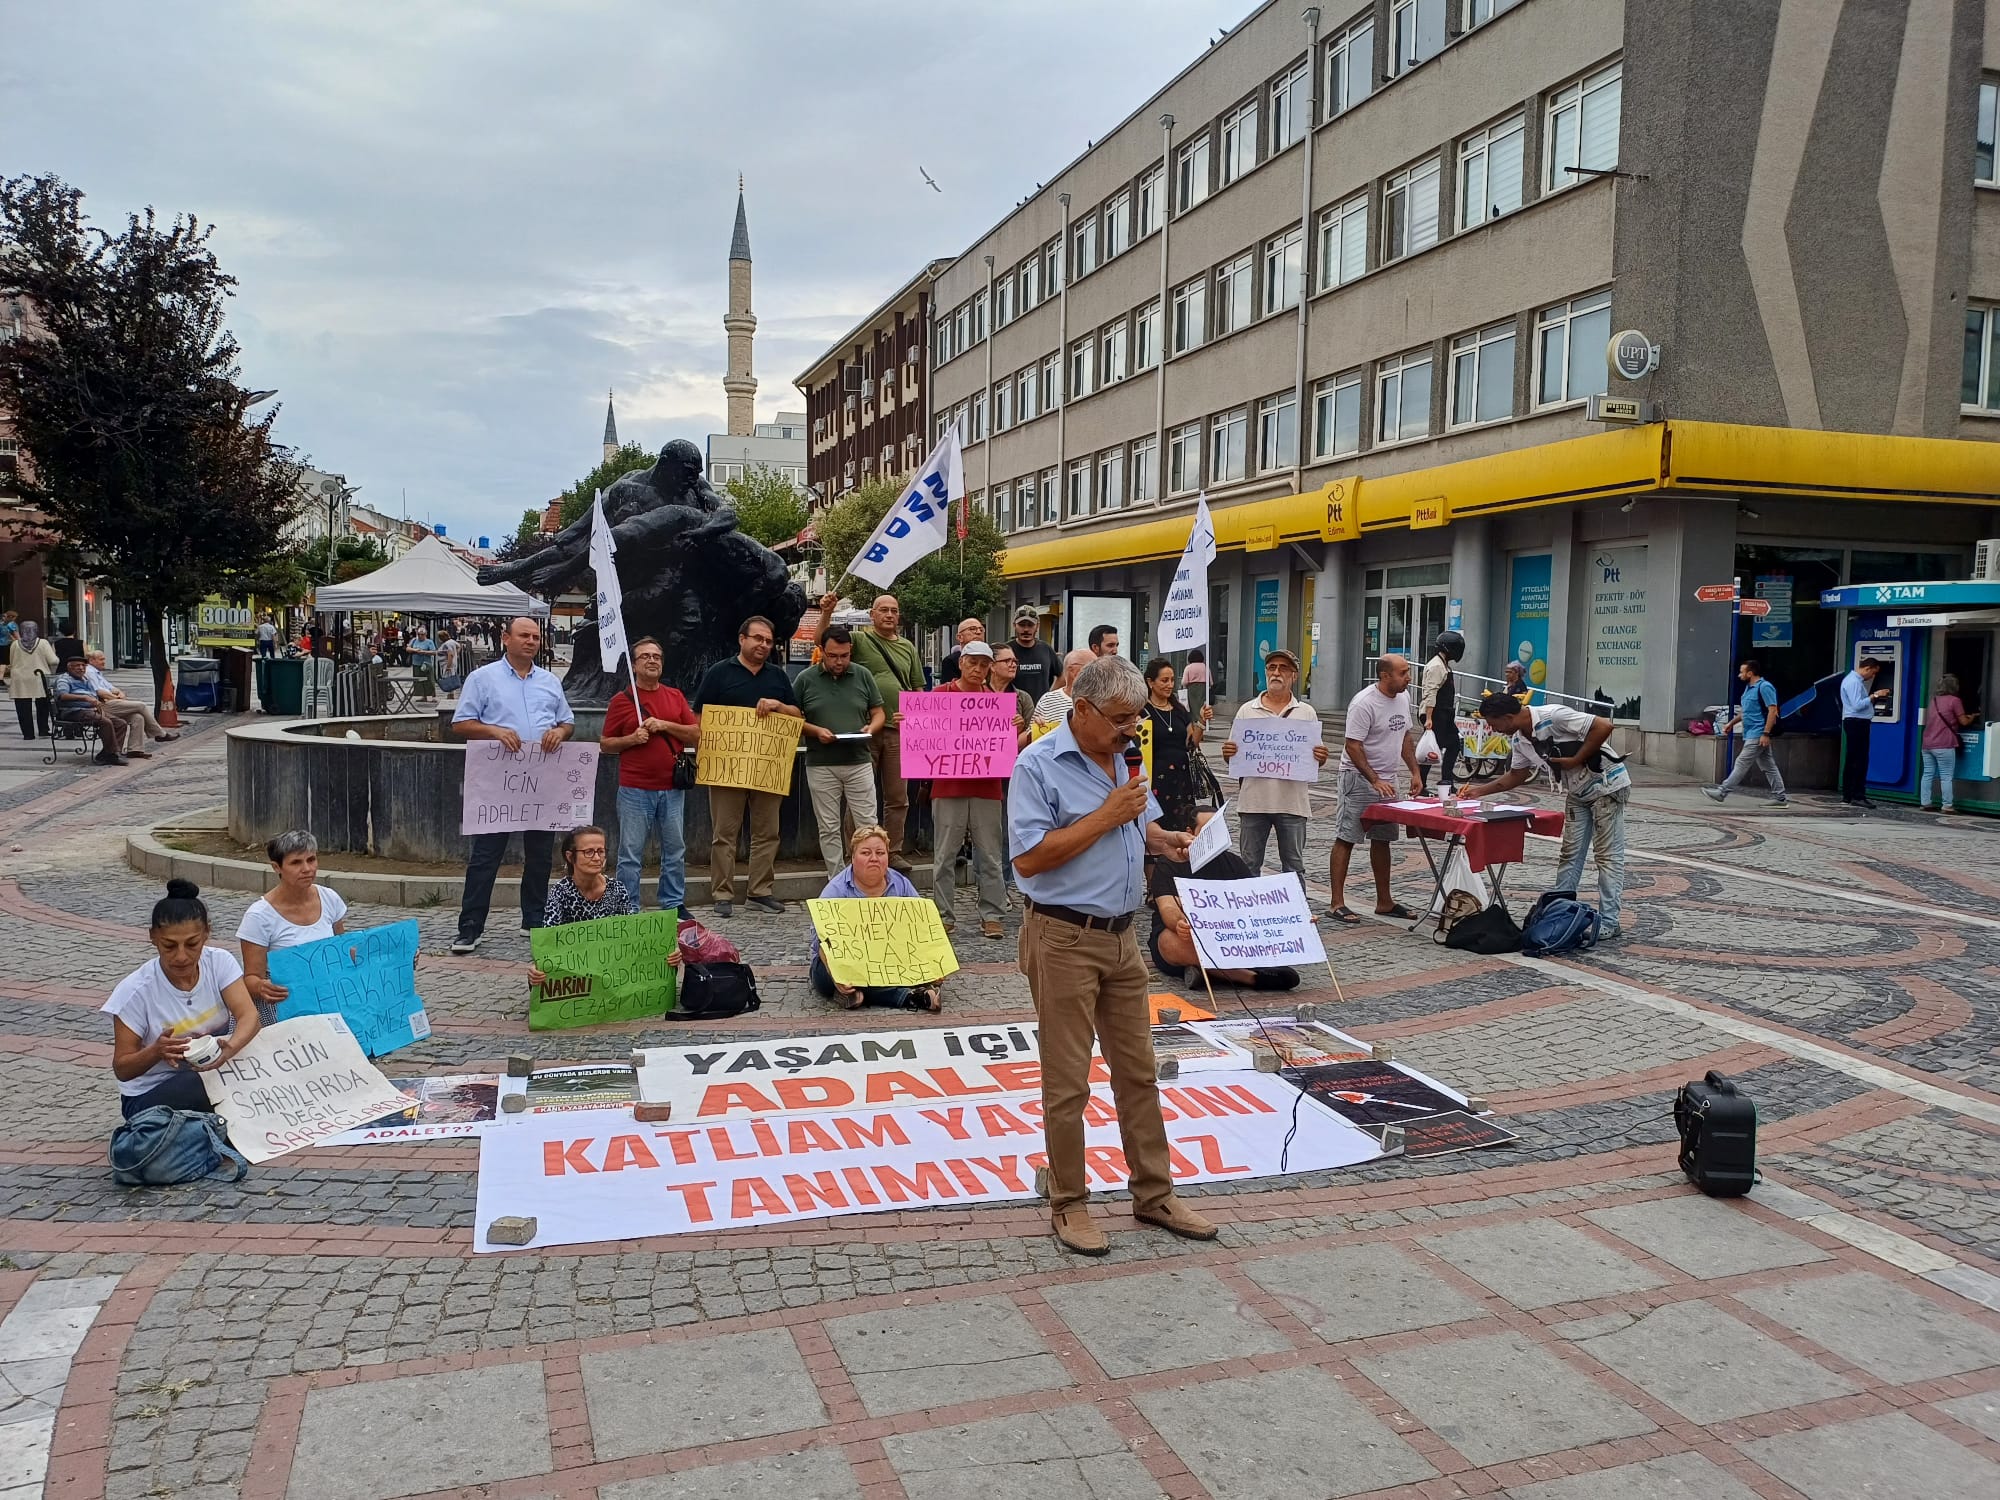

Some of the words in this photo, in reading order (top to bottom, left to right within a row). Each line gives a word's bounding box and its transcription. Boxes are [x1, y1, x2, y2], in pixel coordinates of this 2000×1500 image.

[1620, 345, 1647, 359] UPT
[1328, 504, 1342, 523] Ptt
[1604, 567, 1620, 583] Ptt
[1630, 588, 1646, 600] DÖV
[1893, 586, 1925, 598] TAM
[203, 607, 252, 625] 3000
[1602, 625, 1637, 635] CHANGE
[1596, 641, 1642, 650] EXCHANGE
[1598, 656, 1638, 665] WECHSEL
[960, 697, 1000, 712] ÇOCUK
[960, 717, 1010, 732] HAYVAN
[954, 735, 1007, 752] CİNAYET
[1256, 761, 1291, 777] YOK!
[503, 770, 538, 793] İÇİN
[477, 804, 544, 824] ADALET
[555, 919, 629, 948] KÖPEKLER
[635, 916, 664, 937] İÇİN
[824, 922, 896, 941] SEVMEK
[535, 950, 589, 974] ÖZÜM
[684, 1038, 918, 1075] YAŞAM
[943, 1026, 1039, 1060] İÇİ
[218, 1056, 272, 1086] HER
[273, 1037, 329, 1073] GÜN
[232, 1069, 369, 1119] SARAYLARDA
[363, 1125, 474, 1139] ADALET??
[543, 1116, 911, 1177] KATLİAM
